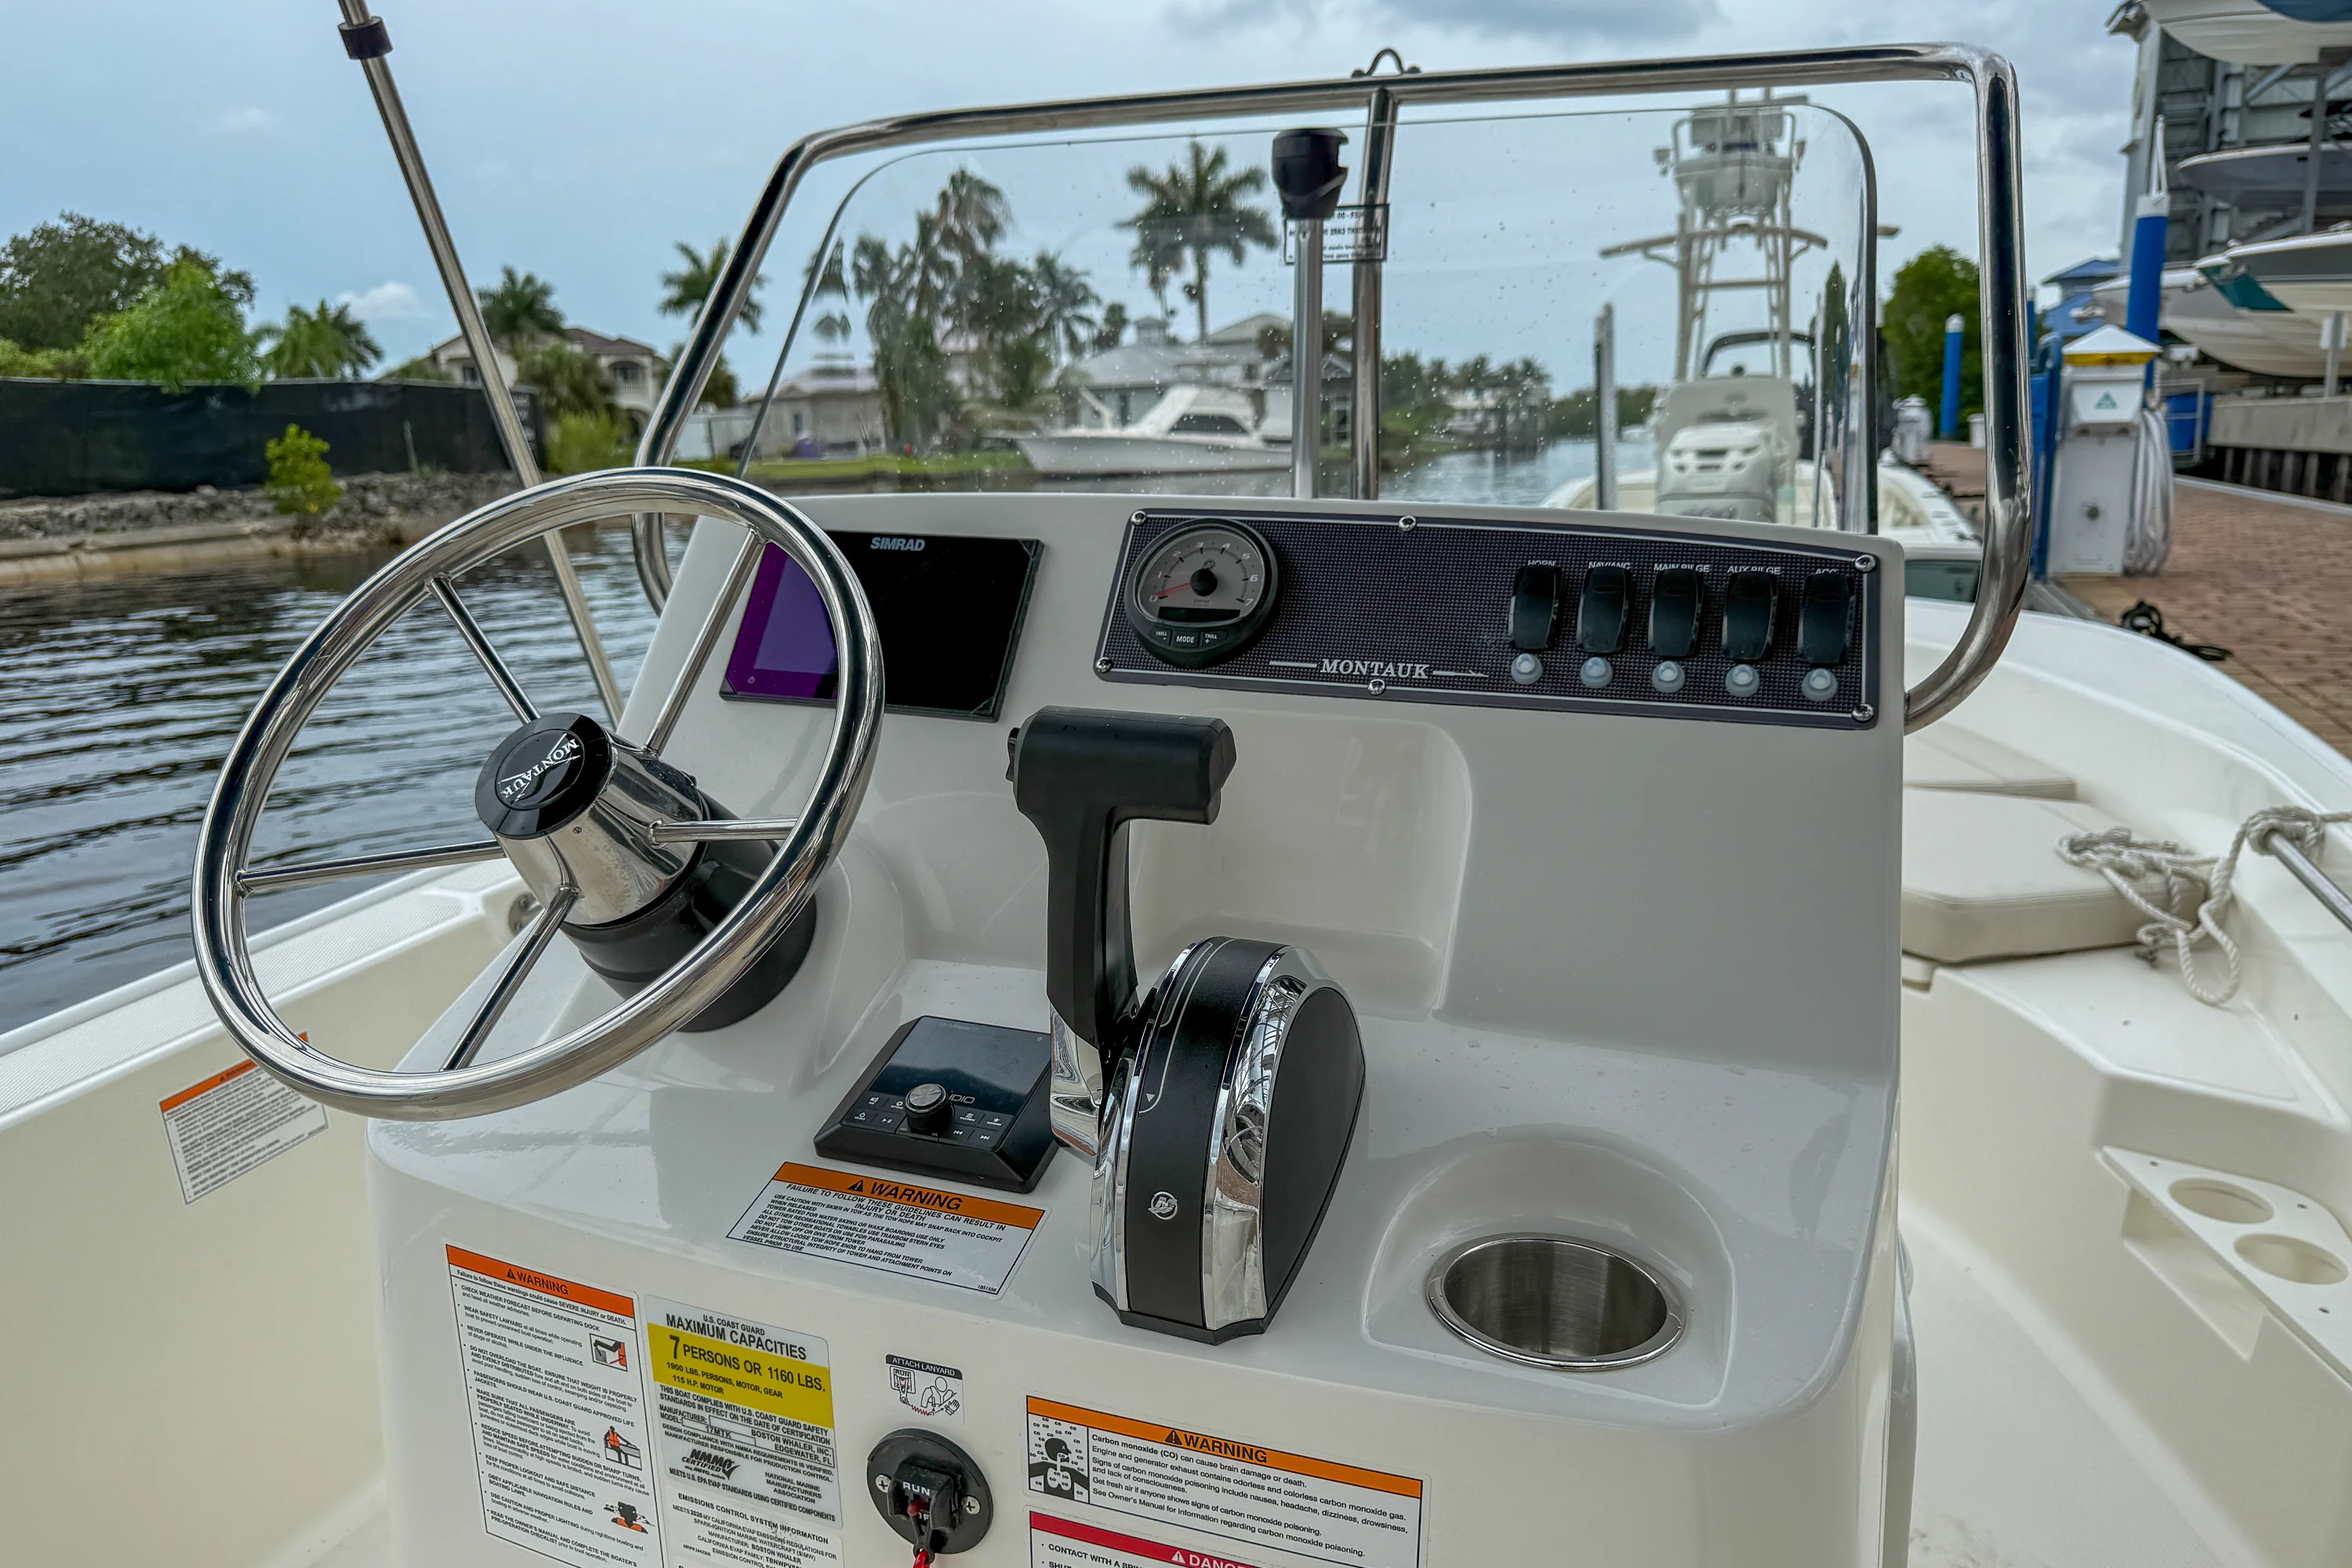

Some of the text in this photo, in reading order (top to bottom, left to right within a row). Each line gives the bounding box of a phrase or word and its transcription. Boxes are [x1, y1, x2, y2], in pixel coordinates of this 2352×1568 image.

[870, 537, 925, 551] SIMRAD
[1244, 598, 1254, 607] 7
[1320, 659, 1430, 679] MONTAUK
[500, 739, 580, 799] MONTAUK
[786, 1183, 819, 1194] FAILURE
[832, 1192, 866, 1203] FOLLOW
[867, 1199, 893, 1208] THESE
[894, 1204, 942, 1218] GUIDELINES
[943, 1214, 962, 1222] CAN
[963, 1218, 994, 1229] RESULT
[870, 1181, 963, 1210] WARNING
[854, 1203, 884, 1213] INJURY
[898, 1211, 926, 1221] DEATH
[666, 1313, 806, 1360] MAXIMUM CAPACITIES
[702, 1314, 765, 1336] U.S. COAST GUARD
[668, 1334, 681, 1359] 7
[682, 1343, 826, 1392] PERSONS OR 1160 LBS.
[892, 1357, 956, 1376] ATTACH LANYARD
[666, 1361, 783, 1399] 1900 LBS. PERSONS, MOTOR, GEAR
[673, 1374, 724, 1395] 115 H.P. MOTOR
[659, 1384, 828, 1436] THIS BOAT COMPLIES WITH U.S. COAST GUARD SAFETY
[659, 1403, 707, 1423] MANUFACTURER:
[659, 1411, 682, 1425] MODEL:
[659, 1392, 830, 1445] STANDARDS IN EFFECT ON THE DATE OF CERTIFICATION
[705, 1425, 731, 1439] 17MTK
[750, 1428, 831, 1457] BOSTON WHALER, INC.
[774, 1443, 831, 1465] EDGEWATER, FL
[1184, 1433, 1267, 1463] WARNING
[1091, 1434, 1119, 1446] Carbon
[1121, 1442, 1158, 1454] monoxide
[1160, 1449, 1178, 1461] (CO)
[1195, 1458, 1218, 1468] cause
[1219, 1462, 1238, 1472] brain
[1240, 1468, 1271, 1480] damage
[1283, 1477, 1306, 1488] death.
[764, 1471, 820, 1492] NATIONAL MARINE
[766, 1479, 822, 1499] MANUFACTURERS
[902, 1481, 931, 1496] RUN
[1092, 1445, 1116, 1457] Engine
[1134, 1456, 1167, 1468] generator
[1170, 1465, 1198, 1475] exhaust
[1200, 1471, 1231, 1483] contains
[1232, 1479, 1265, 1490] odorless
[1283, 1490, 1317, 1502] colorless
[1319, 1497, 1346, 1508] carbon
[1348, 1504, 1387, 1516] monoxide
[1107, 1468, 1122, 1478] lack
[1132, 1475, 1187, 1493] consciousness.
[773, 1487, 815, 1504] ASSOCIATION
[1092, 1457, 1112, 1467] Signs
[1121, 1465, 1146, 1475] carbon
[1148, 1471, 1182, 1483] monoxide
[1184, 1479, 1220, 1493] poisoning
[1221, 1486, 1248, 1498] include
[1250, 1494, 1278, 1506] nausea,
[1280, 1499, 1319, 1515] headache,
[1321, 1509, 1359, 1524] dizziness,
[1361, 1518, 1407, 1534] drowsiness,
[1092, 1476, 1105, 1485] Get
[1105, 1479, 1123, 1490] fresh
[1140, 1489, 1165, 1499] anyone
[1167, 1494, 1189, 1505] shows
[1191, 1500, 1210, 1510] signs
[1219, 1508, 1245, 1518] carbon
[1247, 1513, 1282, 1526] monoxide
[1283, 1522, 1321, 1536] poisoning.
[1092, 1487, 1106, 1497] See
[1108, 1491, 1137, 1504] Owner's
[1138, 1498, 1164, 1510] Manual
[1178, 1508, 1218, 1523] information
[1220, 1519, 1256, 1533] regarding
[1257, 1527, 1283, 1538] carbon
[1286, 1534, 1323, 1547] monoxide
[1324, 1543, 1365, 1557] poisoning.
[1048, 1544, 1088, 1559] CONTACT
[1090, 1554, 1112, 1566] WITH
